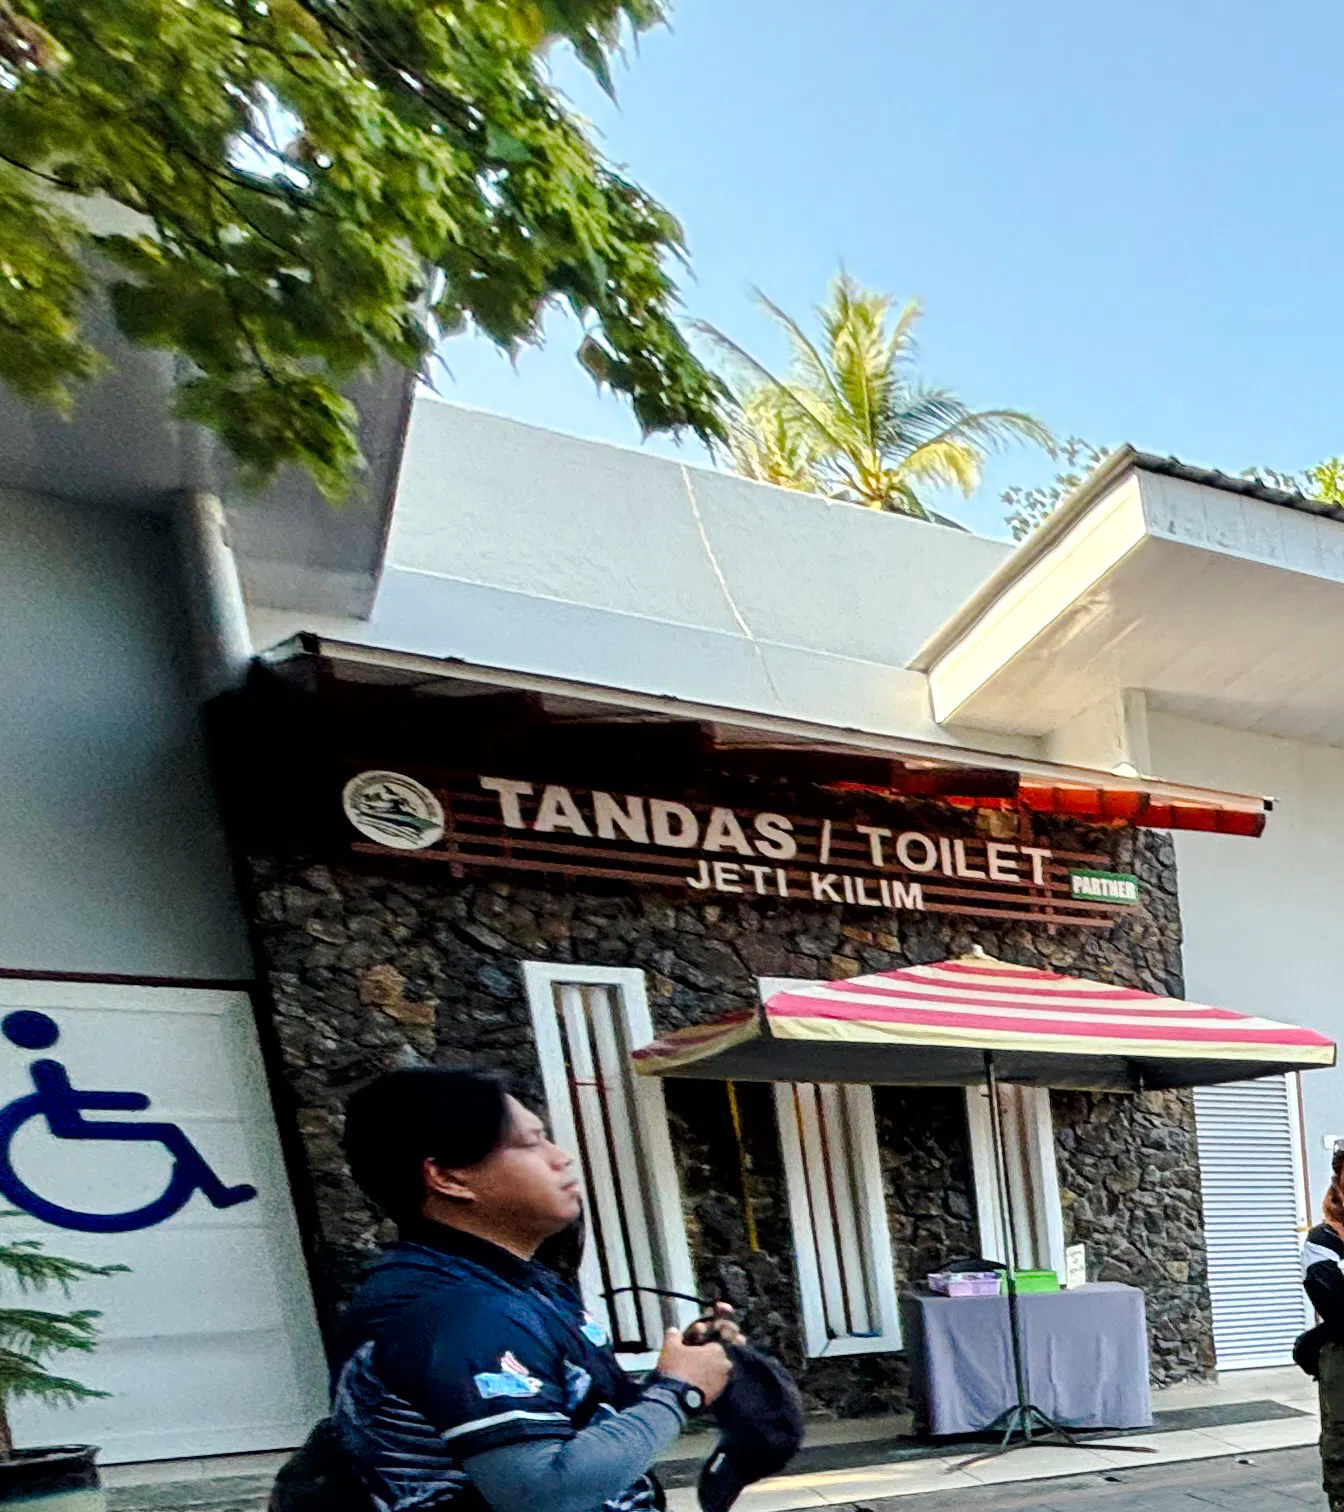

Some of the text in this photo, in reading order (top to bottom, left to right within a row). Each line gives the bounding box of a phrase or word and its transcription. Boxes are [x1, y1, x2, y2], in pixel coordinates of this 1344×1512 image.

[479, 776, 797, 860] TANDAS
[819, 819, 831, 865] /
[856, 824, 1052, 886] TOILET
[686, 859, 924, 911] JETI KILIM
[1072, 875, 1136, 899] PARTNER
